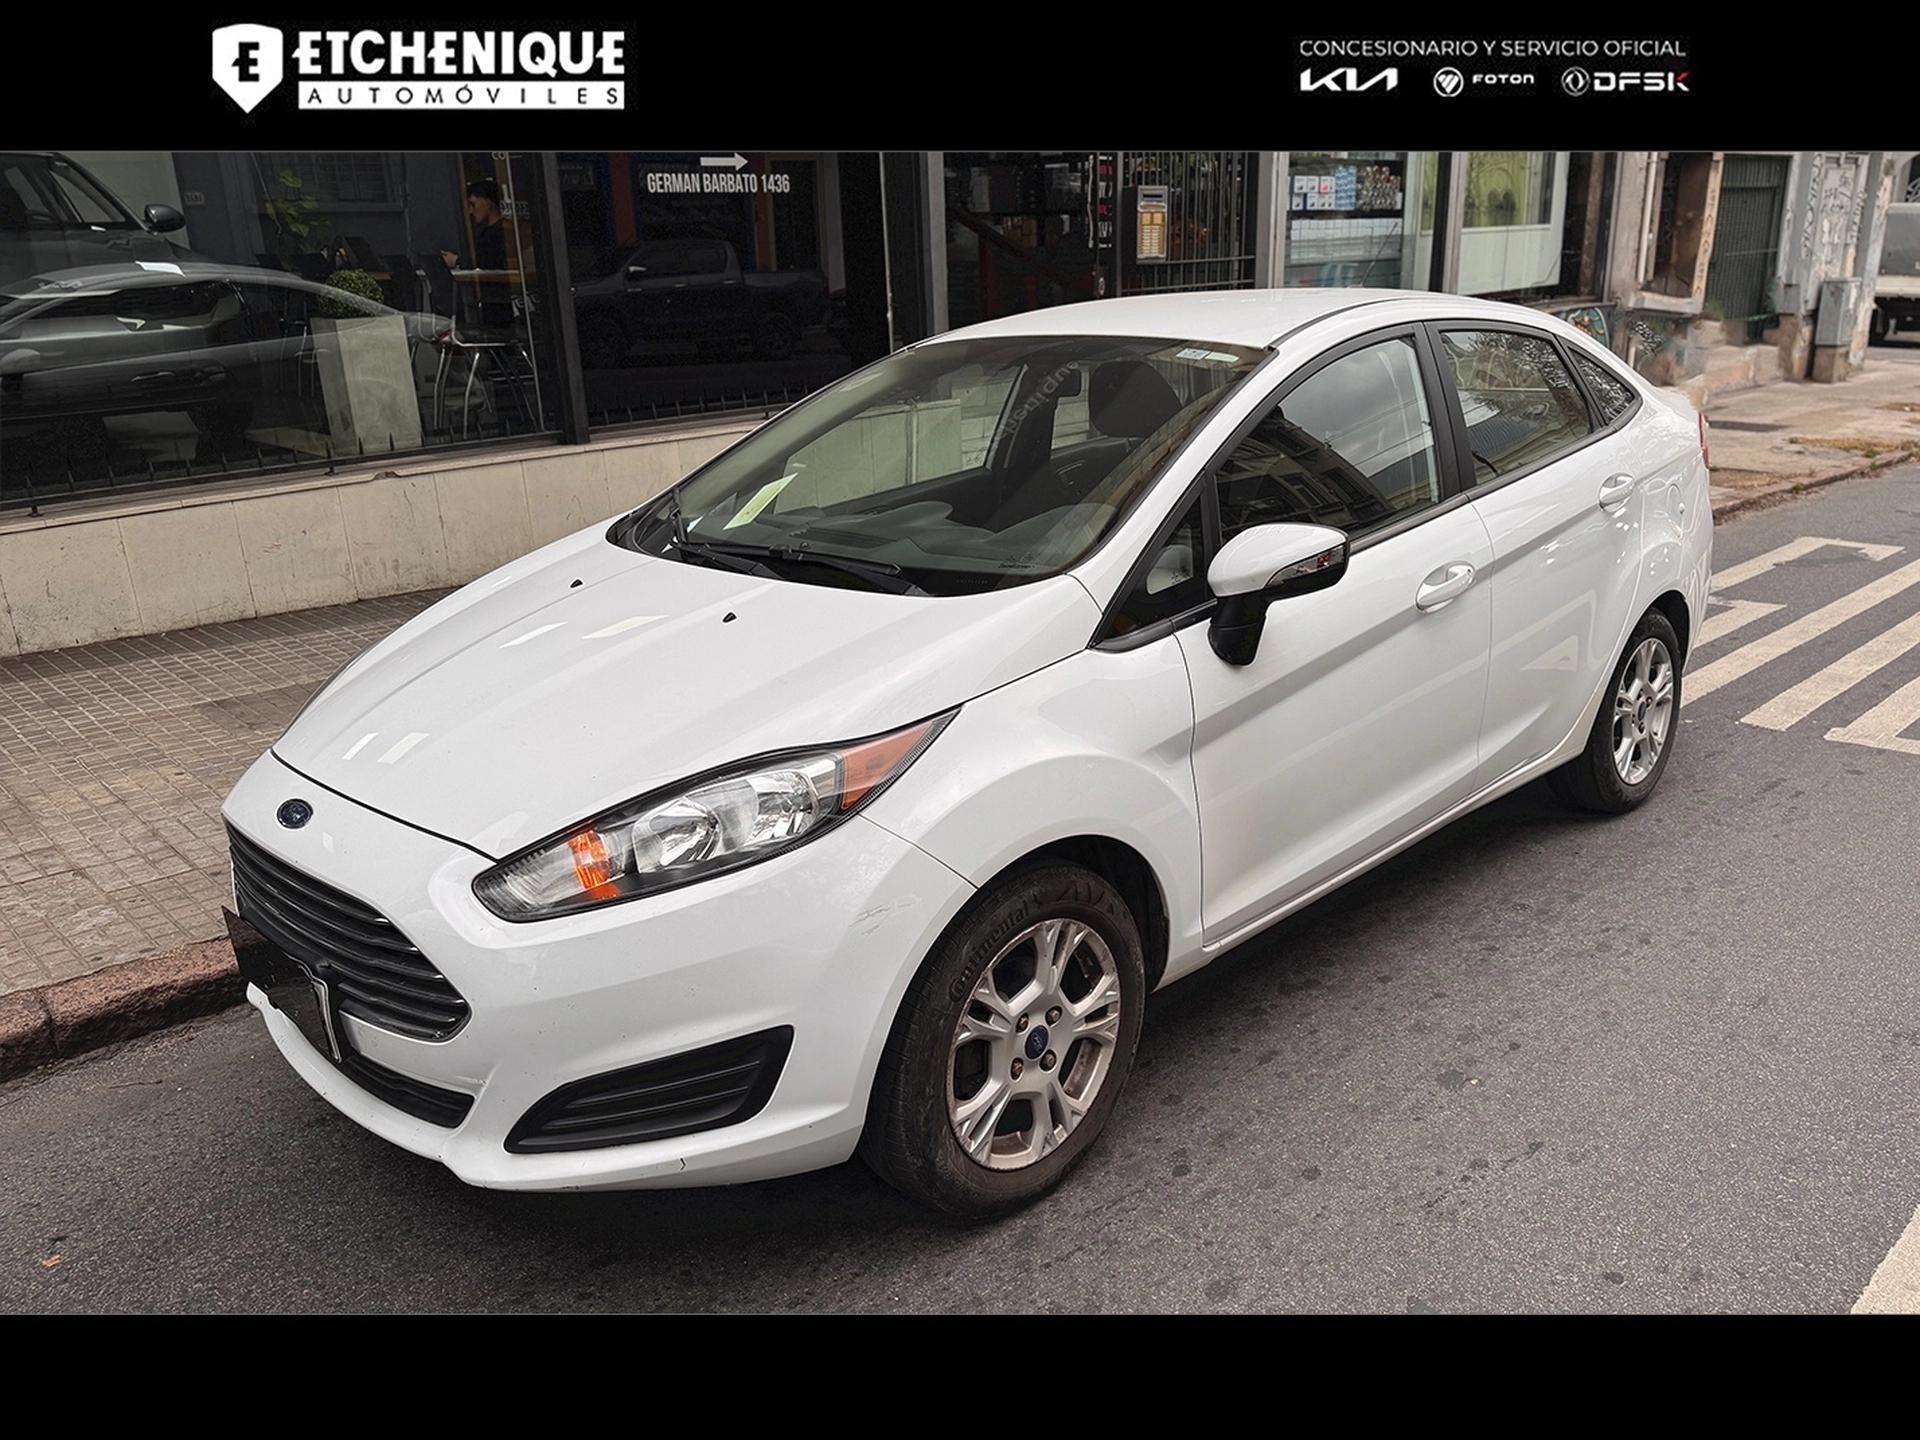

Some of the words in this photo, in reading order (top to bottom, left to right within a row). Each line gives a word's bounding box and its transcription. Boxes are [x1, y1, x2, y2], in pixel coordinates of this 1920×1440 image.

[647, 173, 701, 193] GERMAN
[702, 173, 758, 193] BARBATO
[760, 173, 791, 193] 1436
